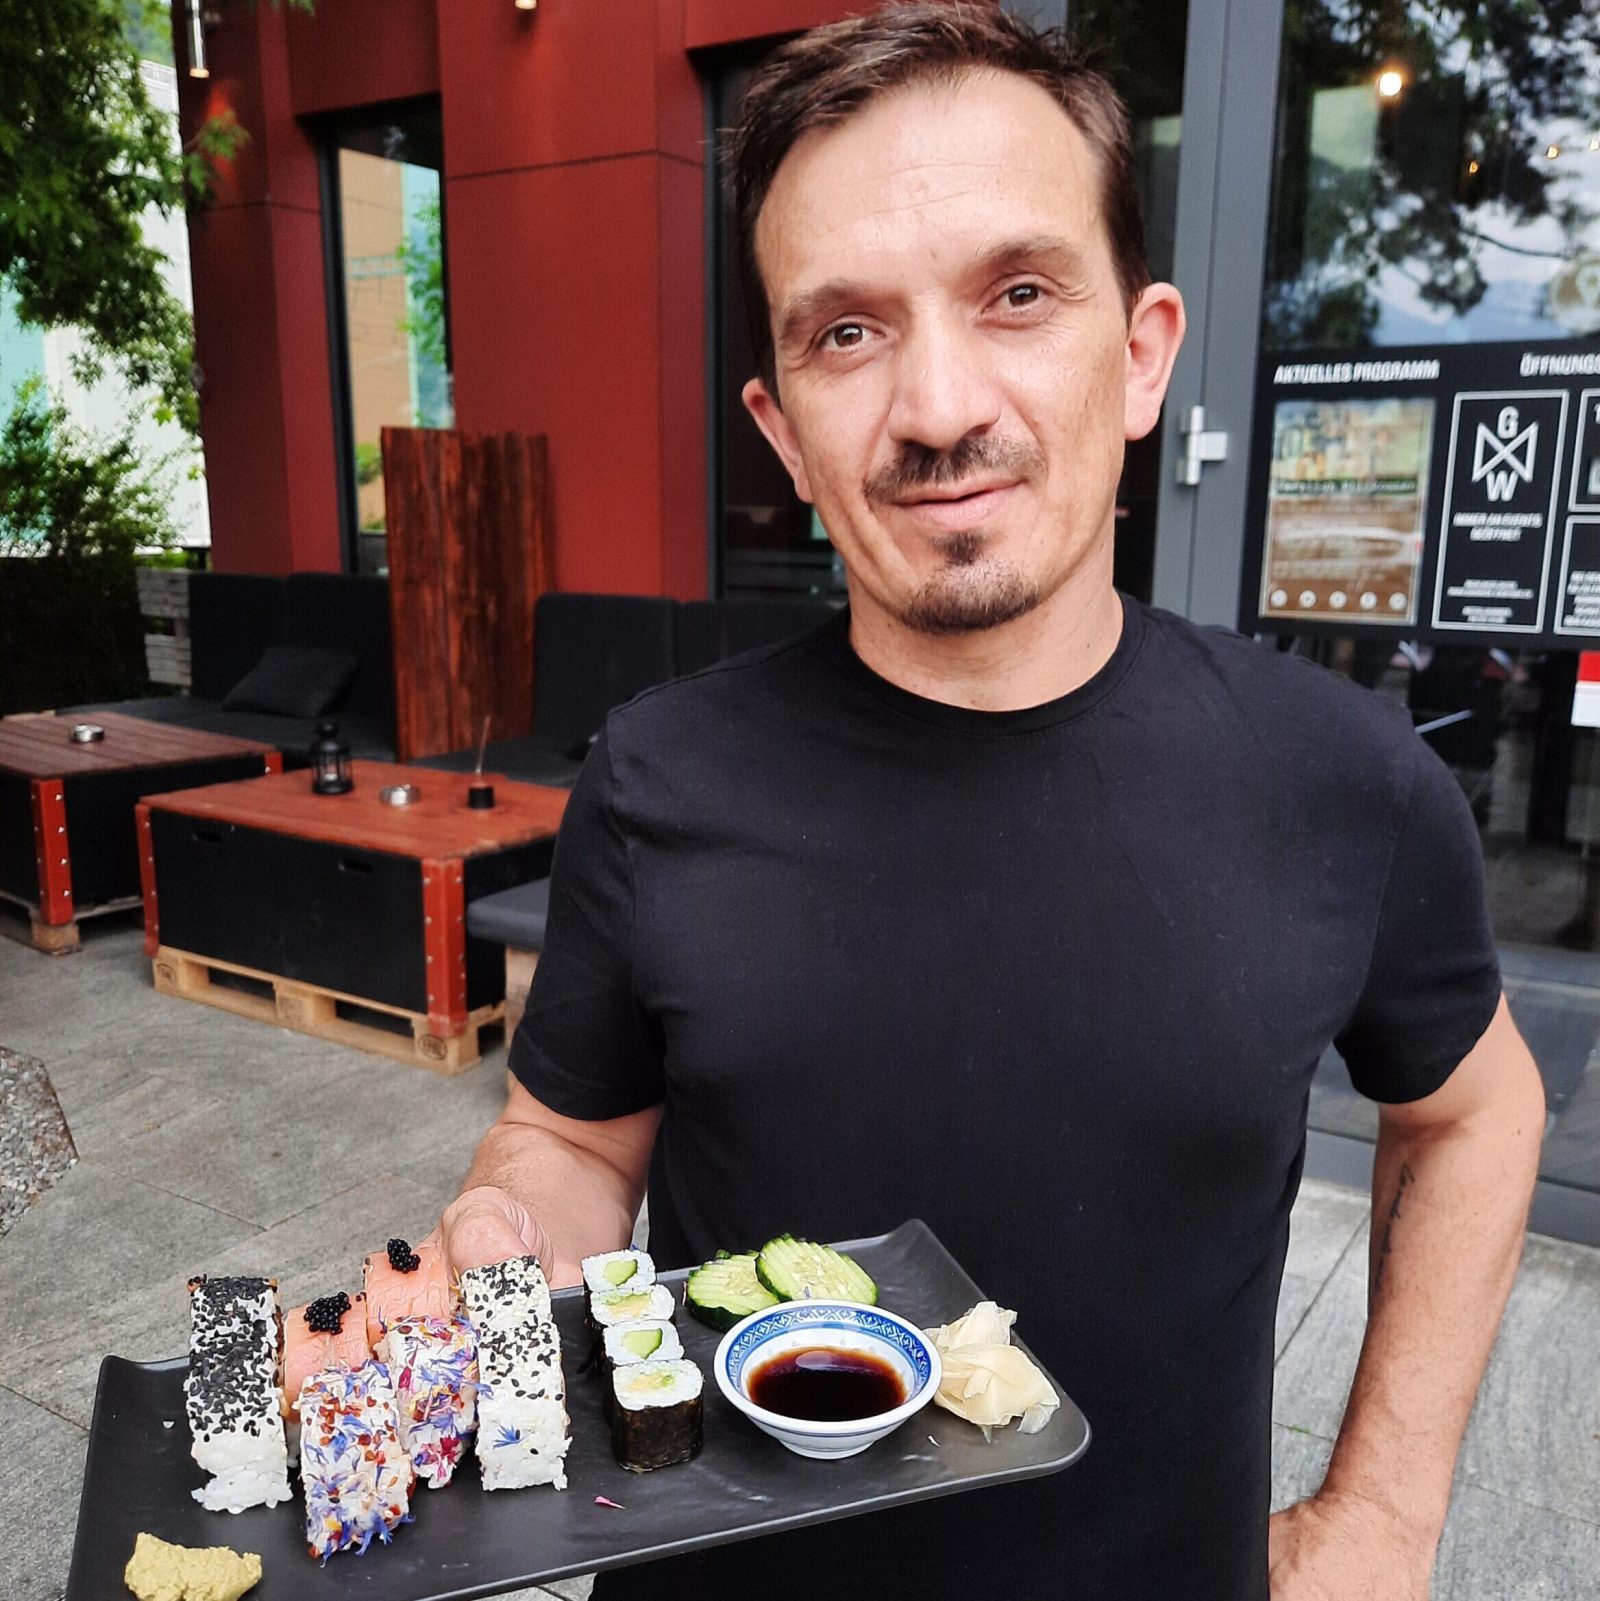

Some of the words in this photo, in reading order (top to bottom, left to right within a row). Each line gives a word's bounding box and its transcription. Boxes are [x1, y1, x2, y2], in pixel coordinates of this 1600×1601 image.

[1273, 363, 1352, 385] AKTUELLES
[1352, 359, 1441, 382] PROGRAMM
[1497, 405, 1519, 439] G
[1486, 470, 1519, 502] W
